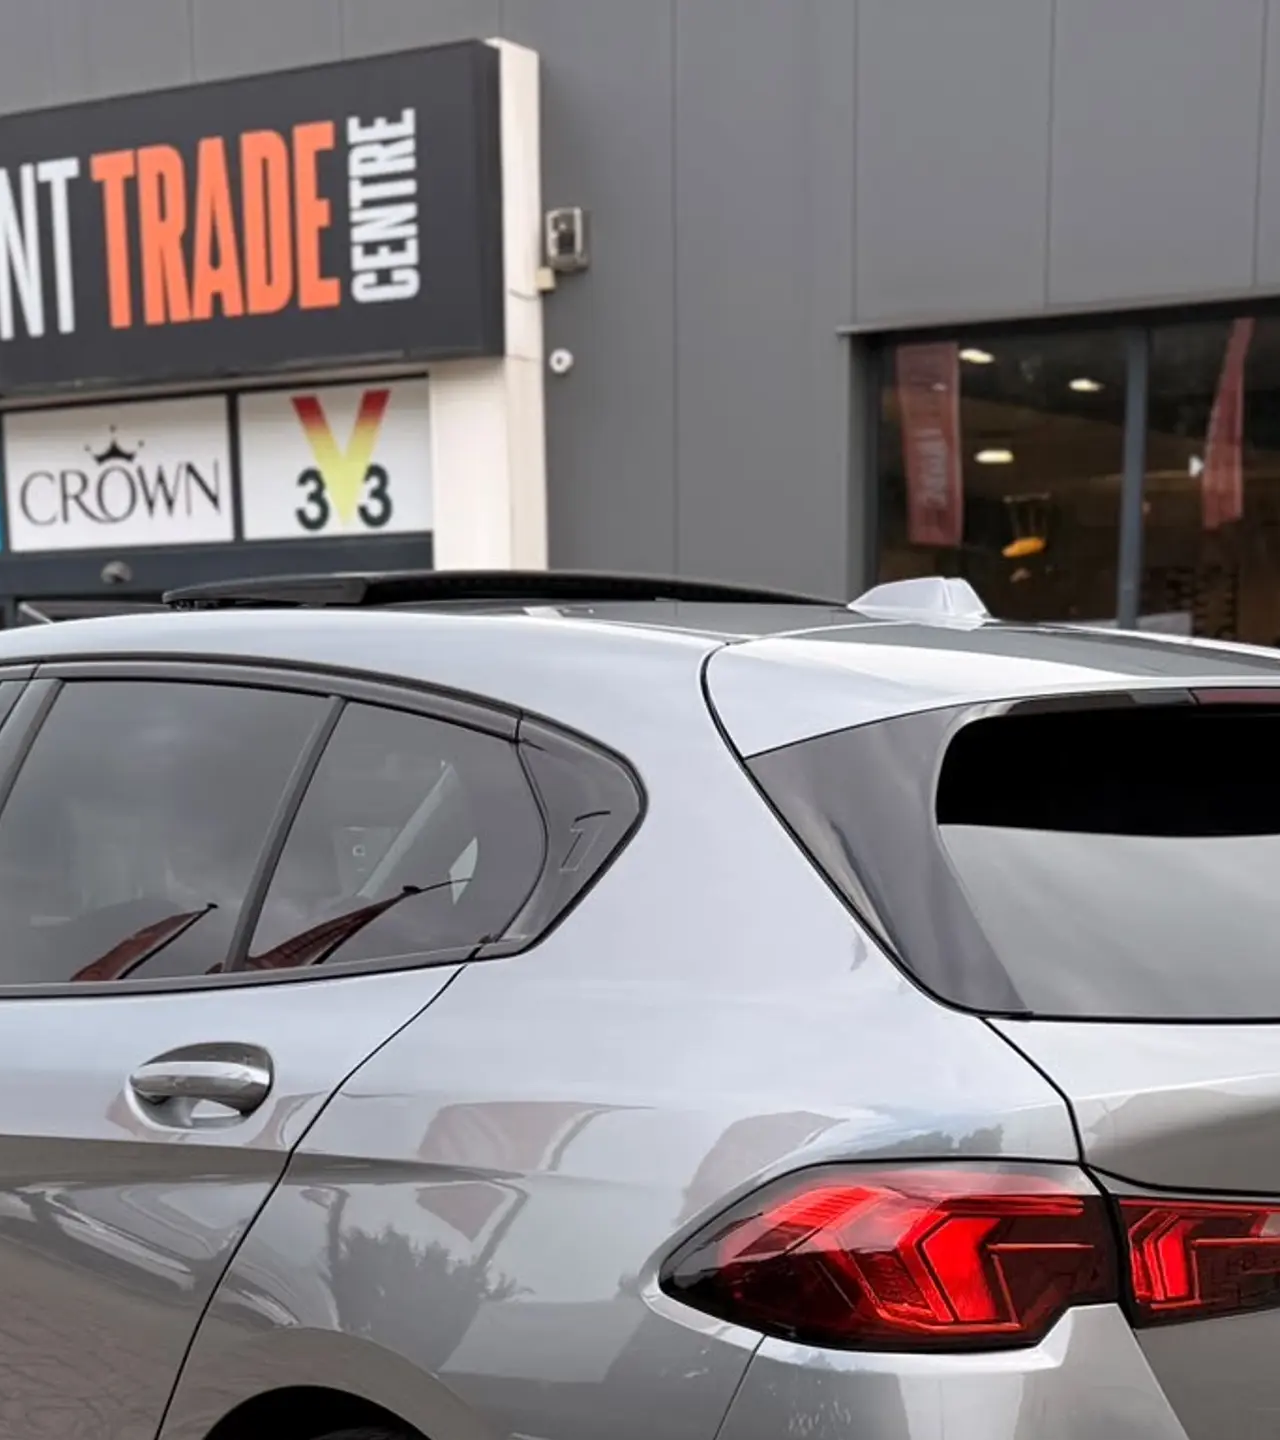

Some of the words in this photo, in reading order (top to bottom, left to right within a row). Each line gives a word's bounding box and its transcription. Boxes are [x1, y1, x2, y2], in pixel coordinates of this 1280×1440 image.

[91, 120, 341, 328] TRADE
[347, 108, 419, 302] CENTRE
[21, 460, 220, 526] CROWN
